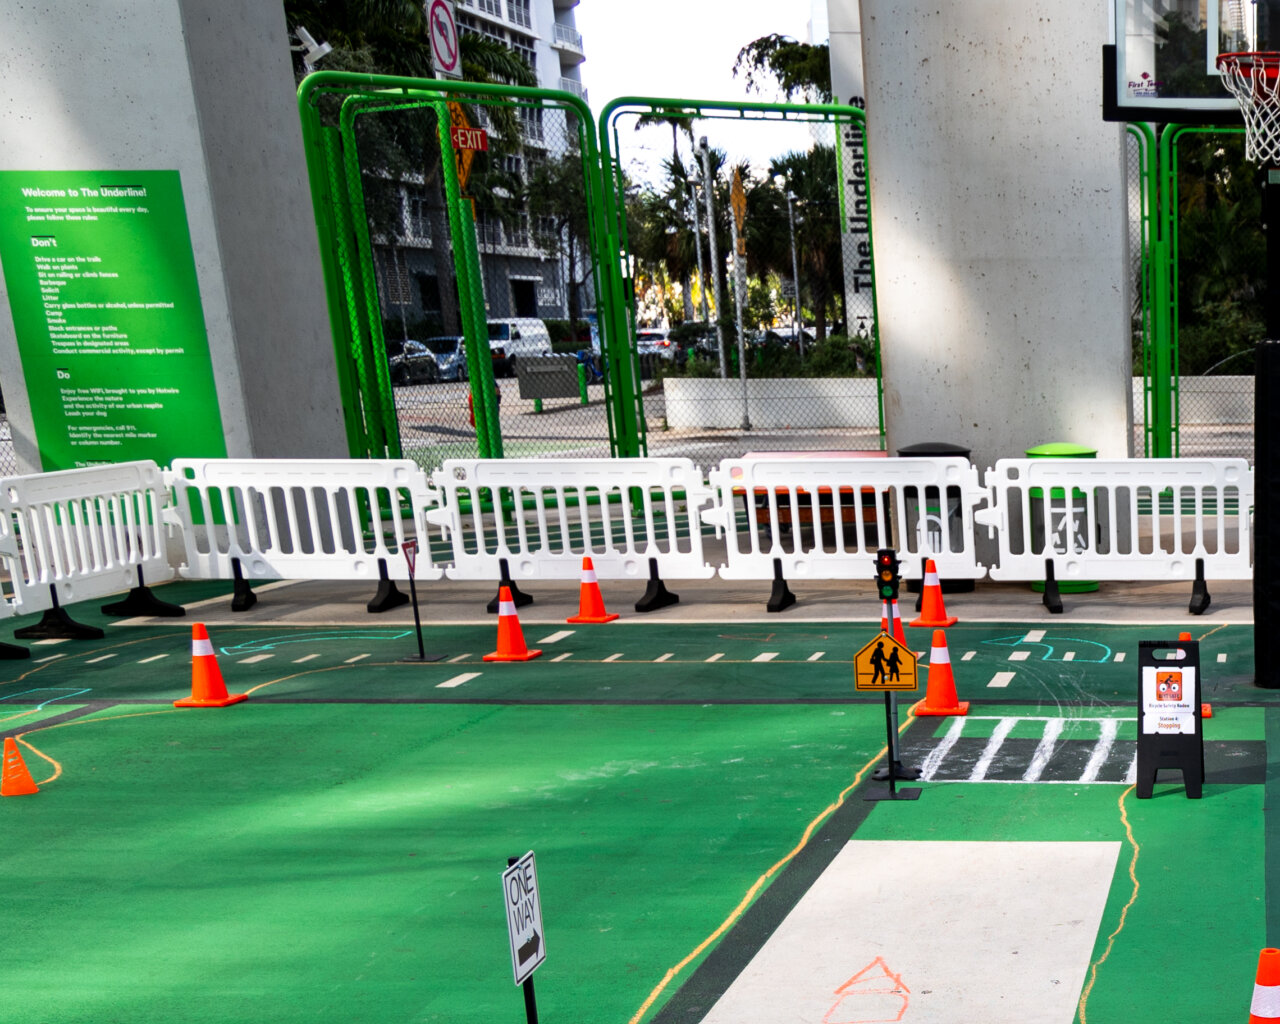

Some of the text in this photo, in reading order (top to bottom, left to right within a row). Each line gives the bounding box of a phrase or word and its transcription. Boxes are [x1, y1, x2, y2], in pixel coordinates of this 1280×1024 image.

[457, 129, 483, 149] EXIT
[21, 187, 147, 197] Welcome to The Underline!
[137, 206, 149, 214] day,
[31, 238, 57, 247] Don't
[853, 241, 873, 293] The
[56, 370, 70, 379] Do
[510, 863, 534, 906] ONE
[513, 893, 535, 935] WAY
